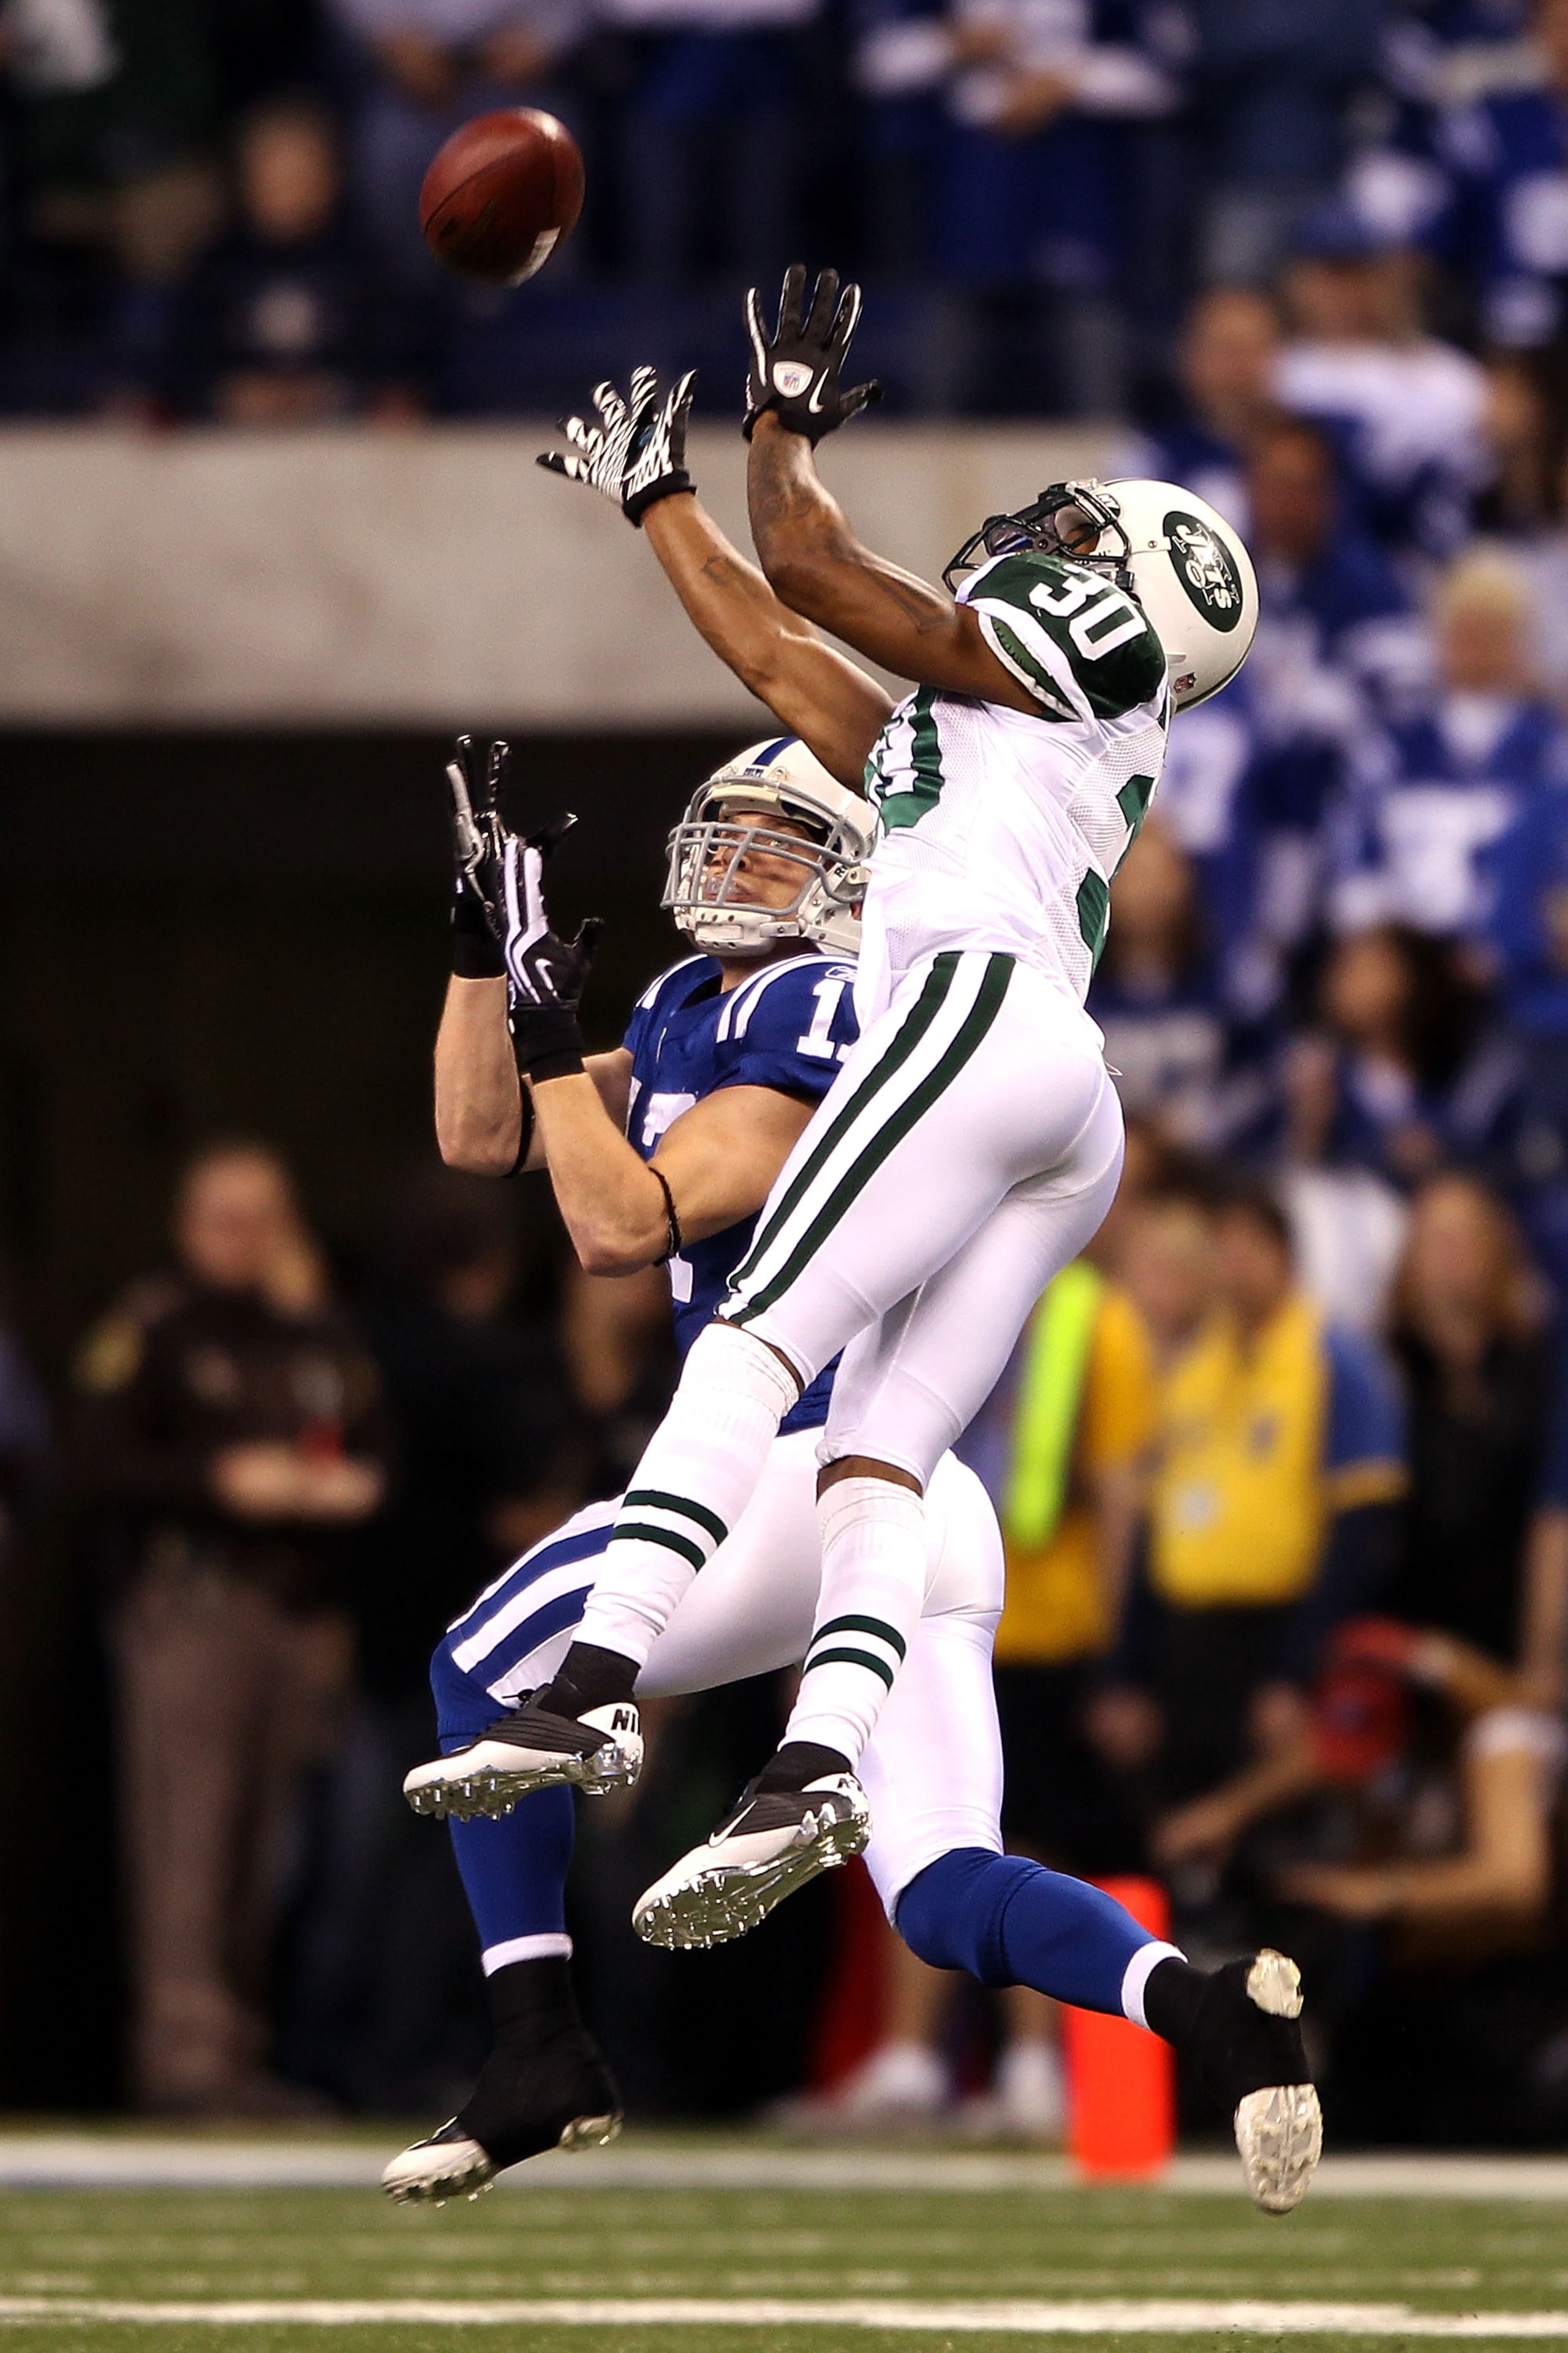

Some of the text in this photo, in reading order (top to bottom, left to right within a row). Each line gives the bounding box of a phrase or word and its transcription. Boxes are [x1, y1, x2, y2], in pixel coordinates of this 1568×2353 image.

[1175, 524, 1232, 609] JETS
[1029, 563, 1148, 661] 30
[862, 683, 945, 839] 0
[796, 978, 852, 1063] 1
[611, 1709, 641, 1736] NI
